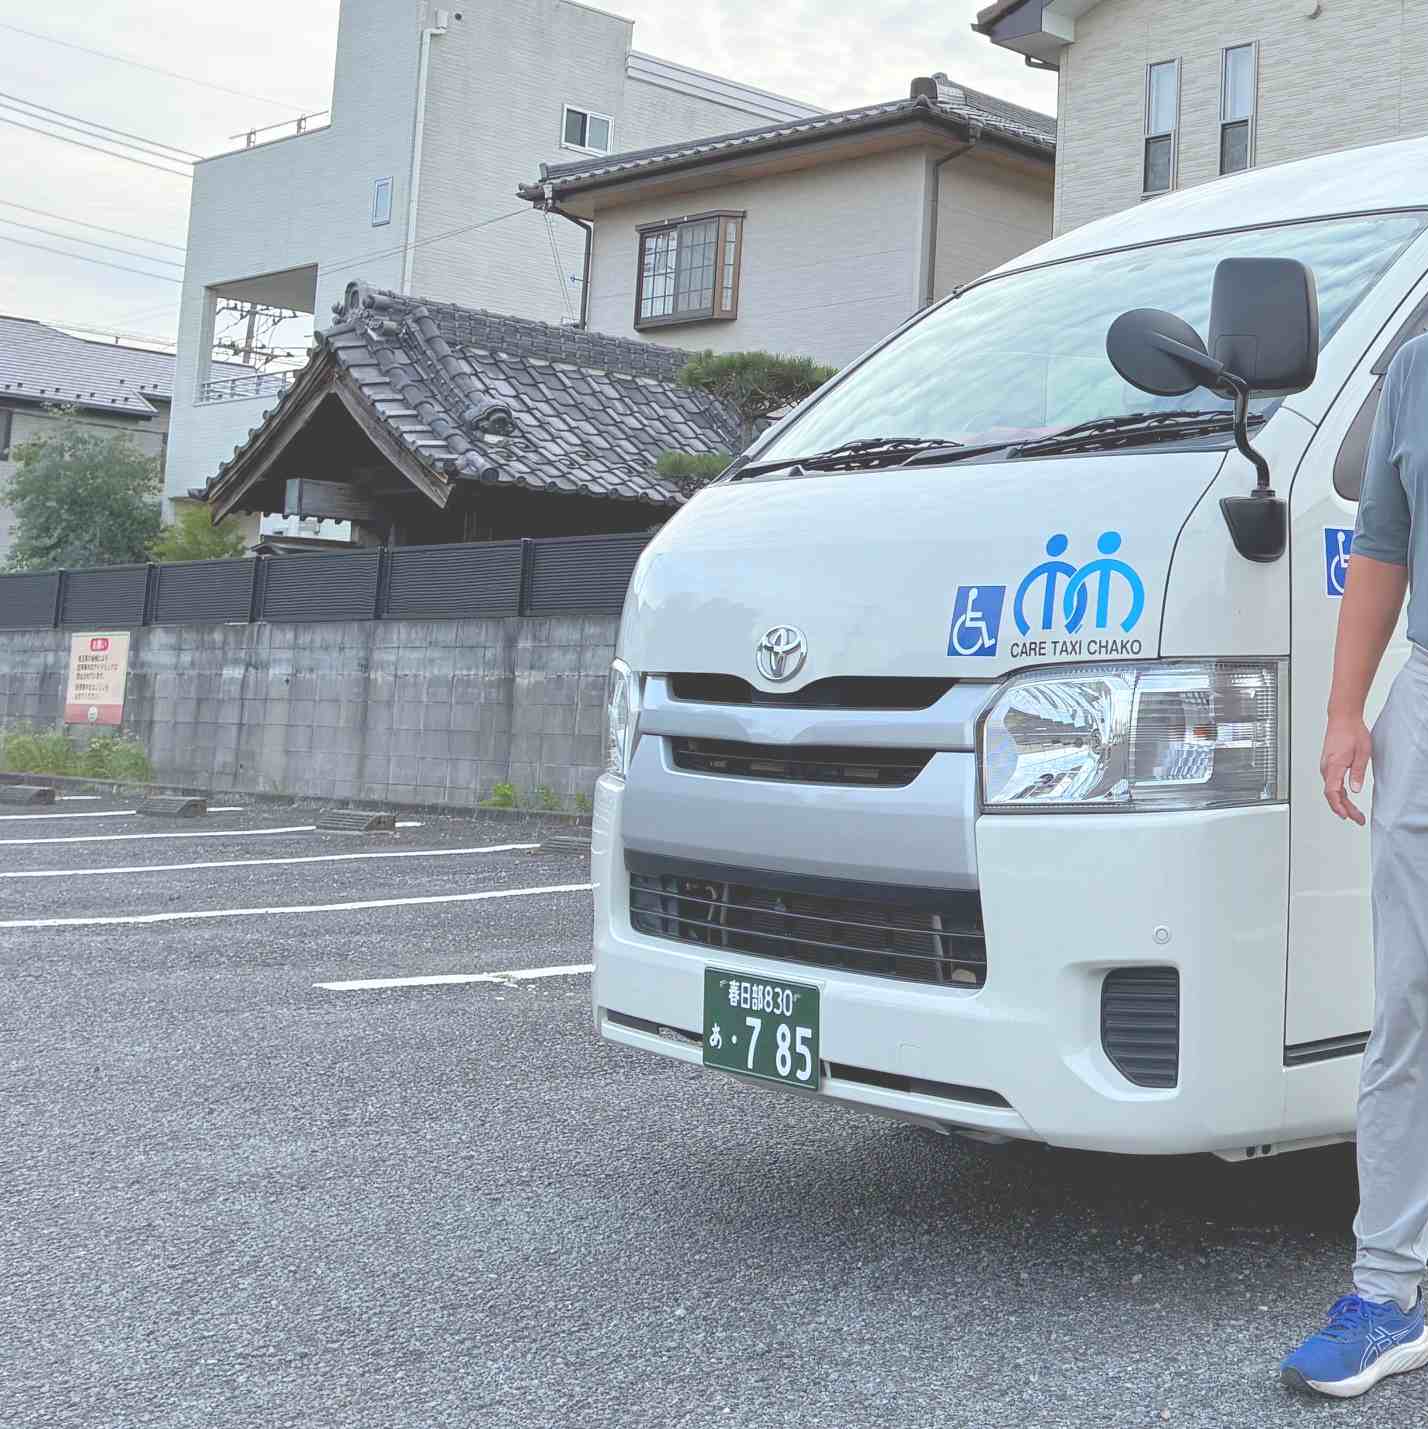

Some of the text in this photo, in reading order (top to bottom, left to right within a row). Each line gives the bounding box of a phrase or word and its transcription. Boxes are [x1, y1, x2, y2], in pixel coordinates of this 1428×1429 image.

[1010, 639, 1142, 658] CARE TAXI CHAKO
